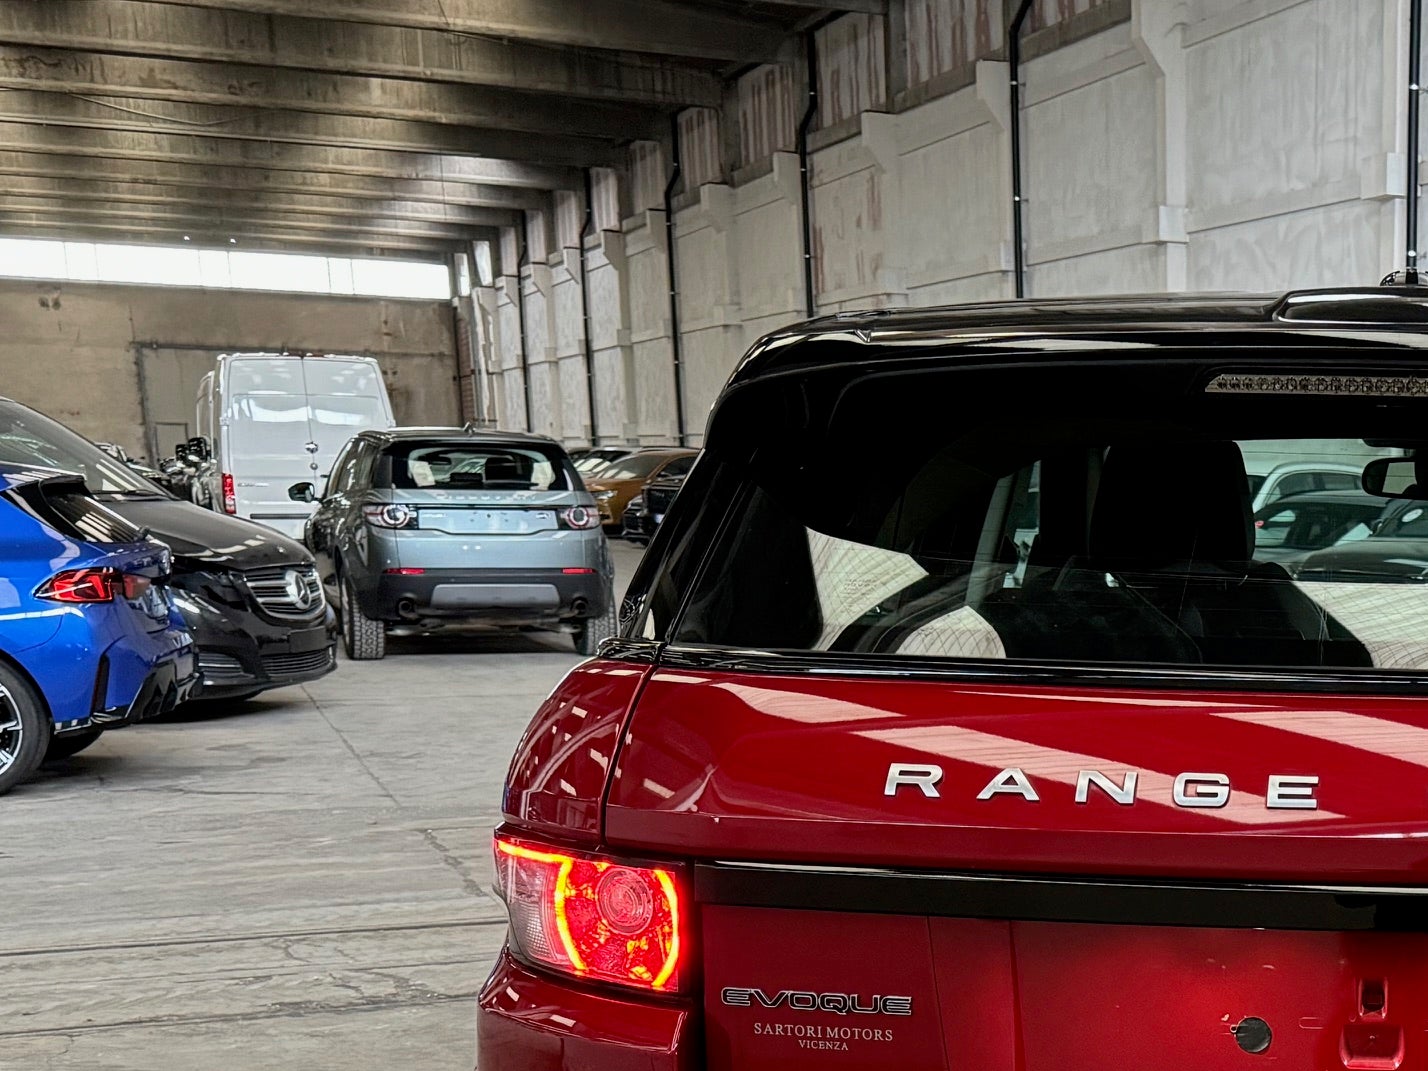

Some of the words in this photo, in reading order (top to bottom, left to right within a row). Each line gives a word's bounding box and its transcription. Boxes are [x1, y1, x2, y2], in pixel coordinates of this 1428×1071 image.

[883, 762, 1320, 810] RANGE
[720, 986, 913, 1016] EVOQUE
[754, 1022, 823, 1038] SARTORI
[826, 1026, 894, 1042] MOTORS
[798, 1039, 850, 1051] VICENZA
